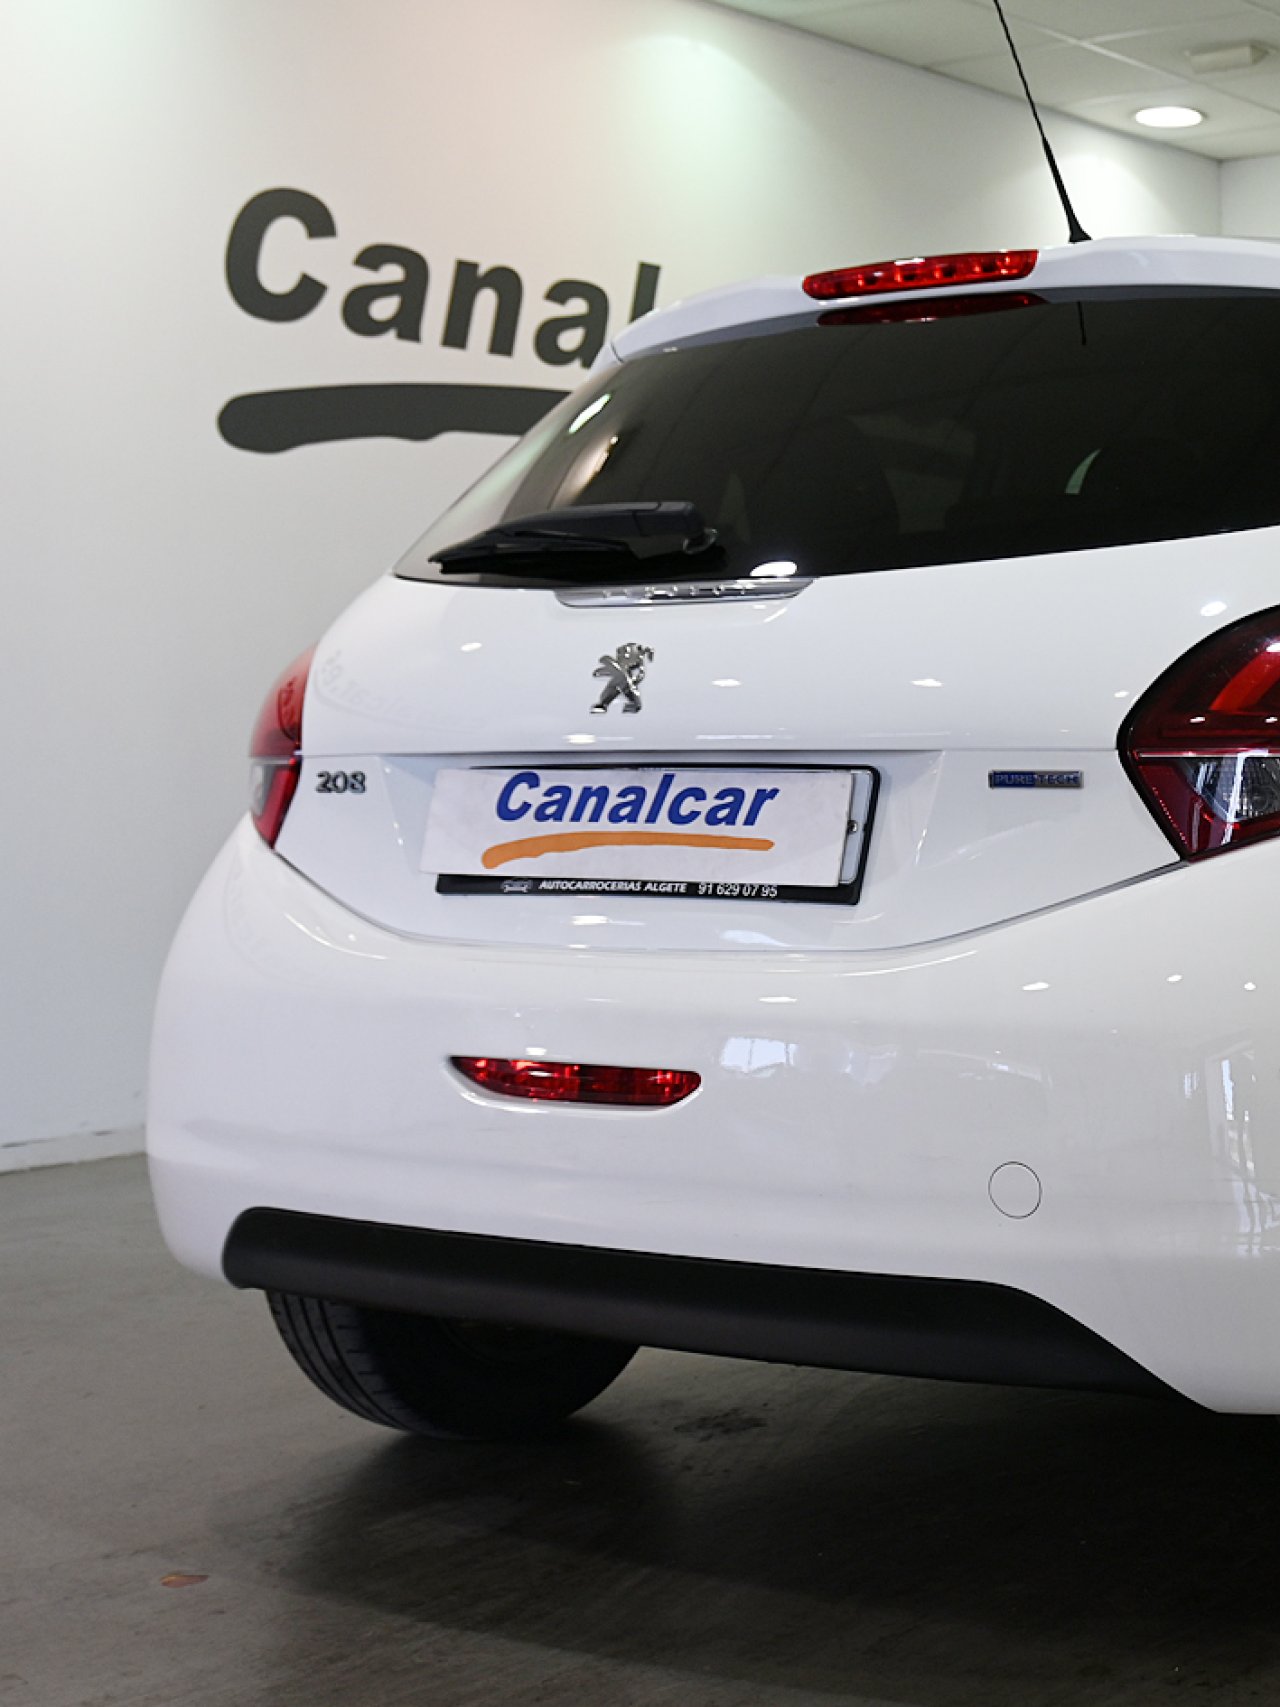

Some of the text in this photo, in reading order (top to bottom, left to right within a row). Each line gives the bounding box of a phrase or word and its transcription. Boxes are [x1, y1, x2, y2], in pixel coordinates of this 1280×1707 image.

[316, 771, 366, 793] 208
[496, 772, 780, 826] Canalcar
[539, 880, 778, 898] AUTOCARROCERIAS ALGETE 91 629 07 95
